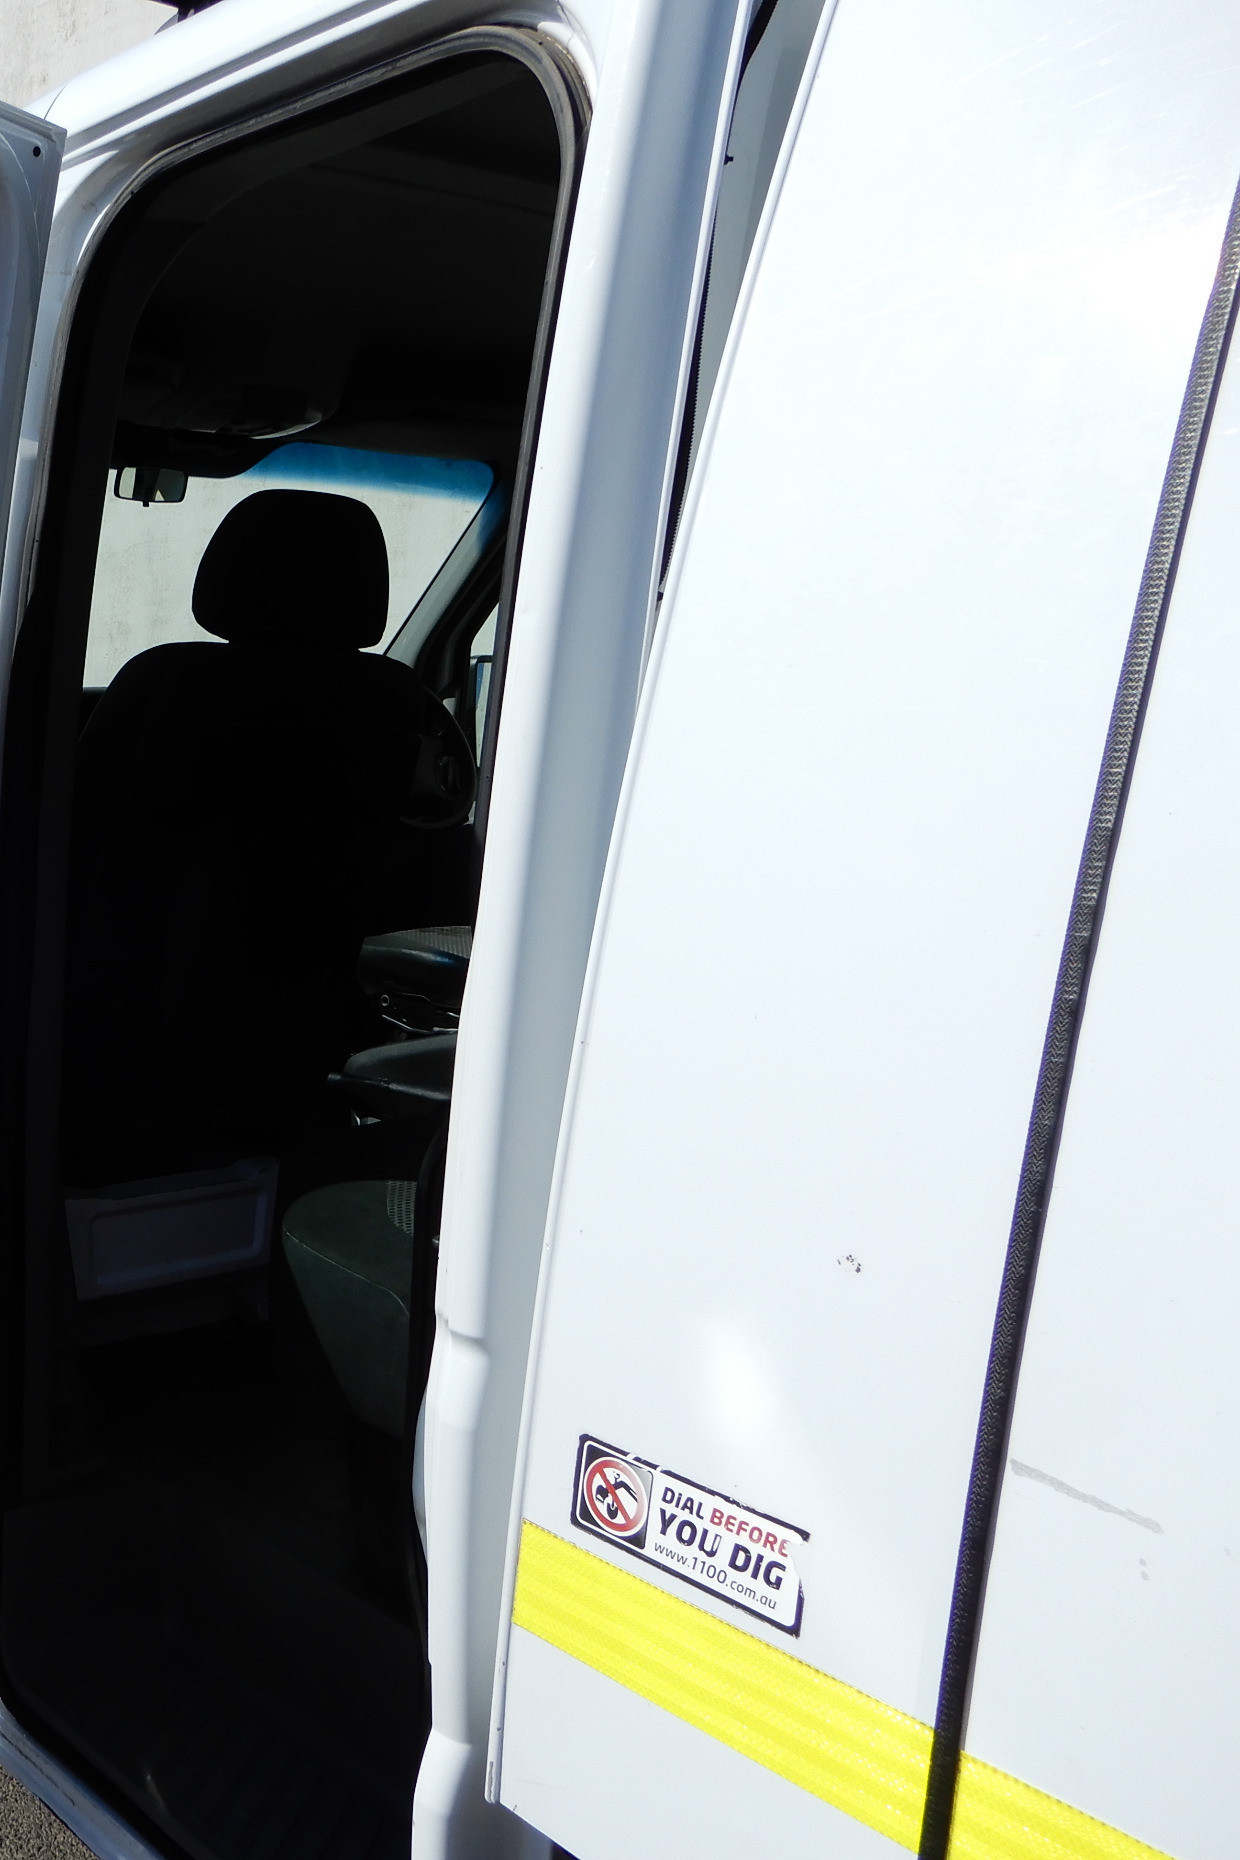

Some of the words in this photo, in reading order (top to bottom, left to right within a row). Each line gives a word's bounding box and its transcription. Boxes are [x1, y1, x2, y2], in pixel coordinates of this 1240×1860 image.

[659, 1507, 722, 1558] YOU
[727, 1542, 787, 1591] DIG
[709, 1507, 789, 1558] BEFORE
[654, 1542, 777, 1610] www.1100.com.au
